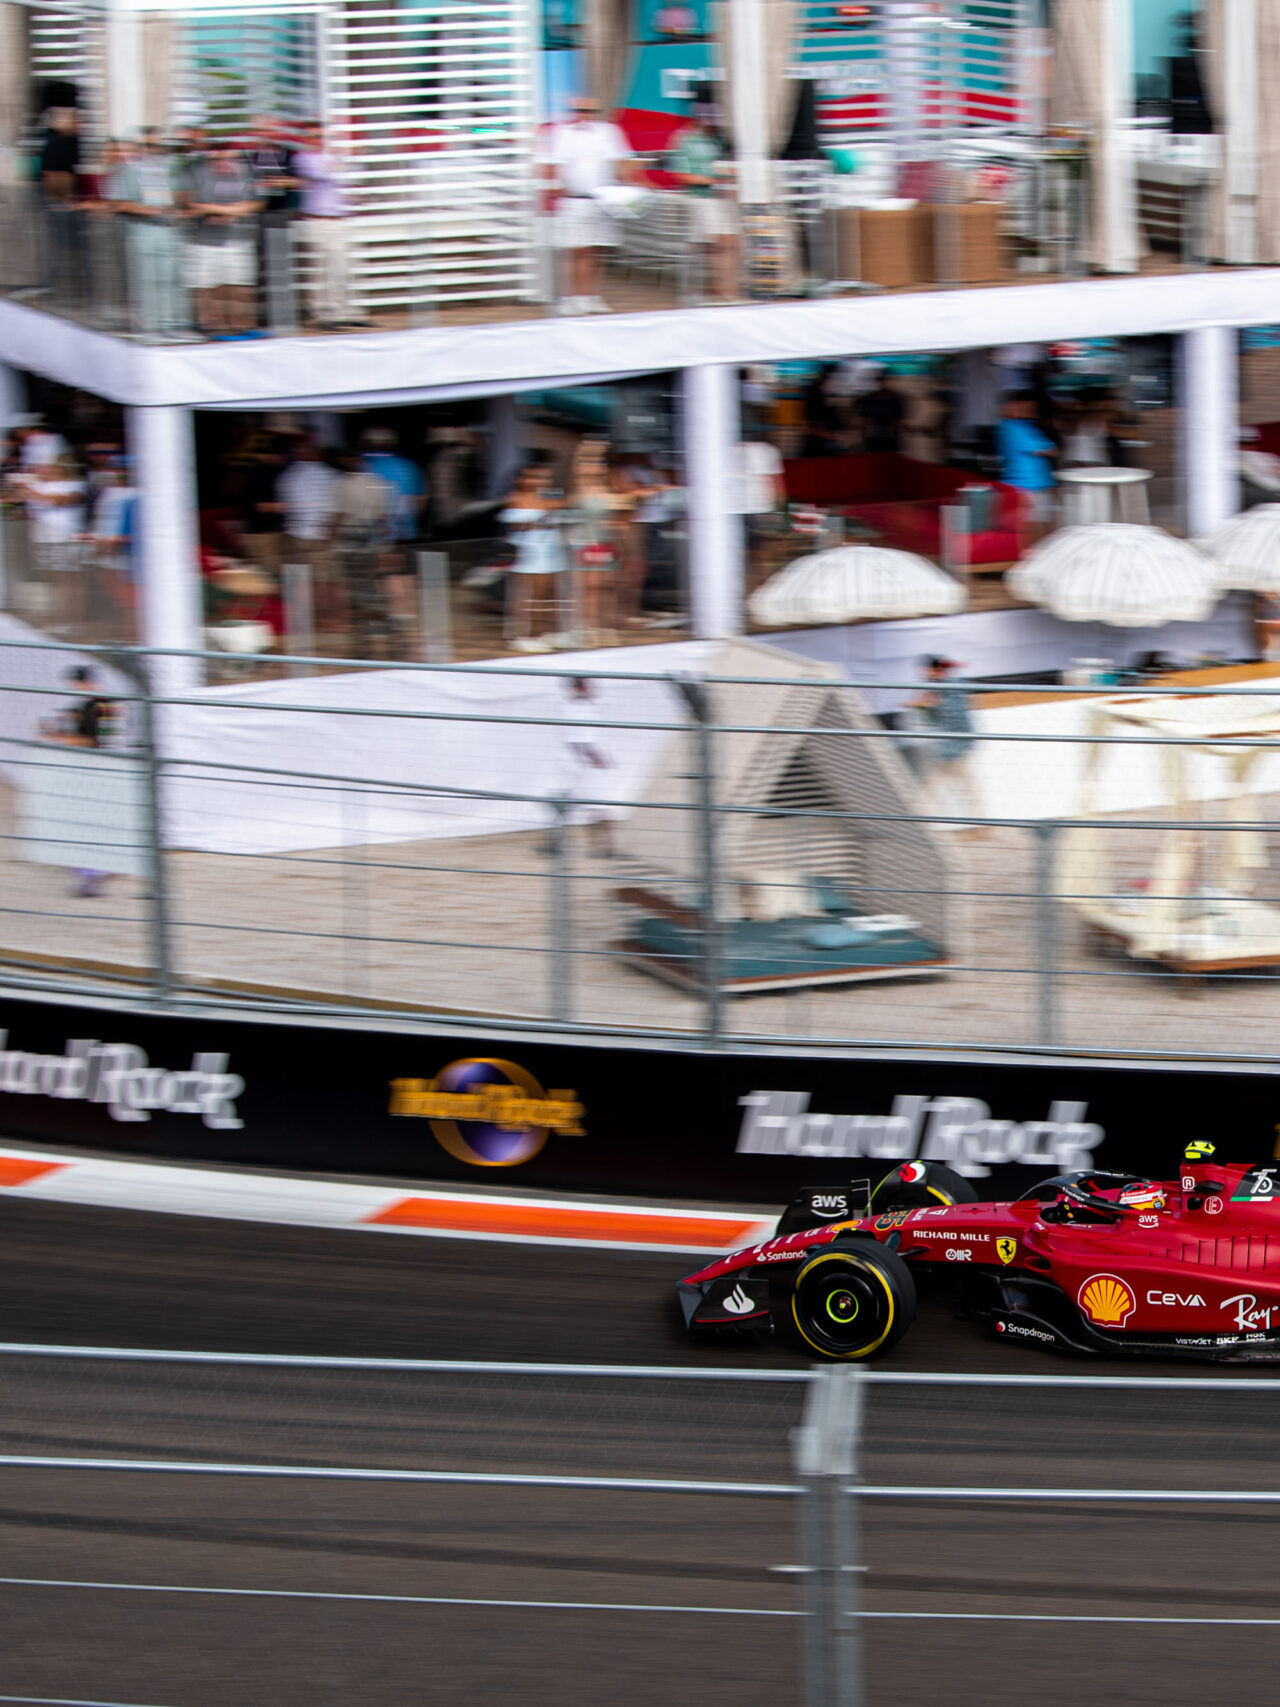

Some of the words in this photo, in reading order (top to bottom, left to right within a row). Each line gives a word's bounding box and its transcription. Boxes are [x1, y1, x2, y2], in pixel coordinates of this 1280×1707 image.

[0, 1028, 101, 1099] ard
[735, 1090, 932, 1157] Hard
[919, 1096, 1104, 1178] Rock
[811, 1195, 847, 1208] aws
[1138, 1214, 1159, 1223] aws
[913, 1230, 957, 1240] RICHARD
[960, 1232, 990, 1242] MILLE
[1008, 1323, 1055, 1342] Snapdragon
